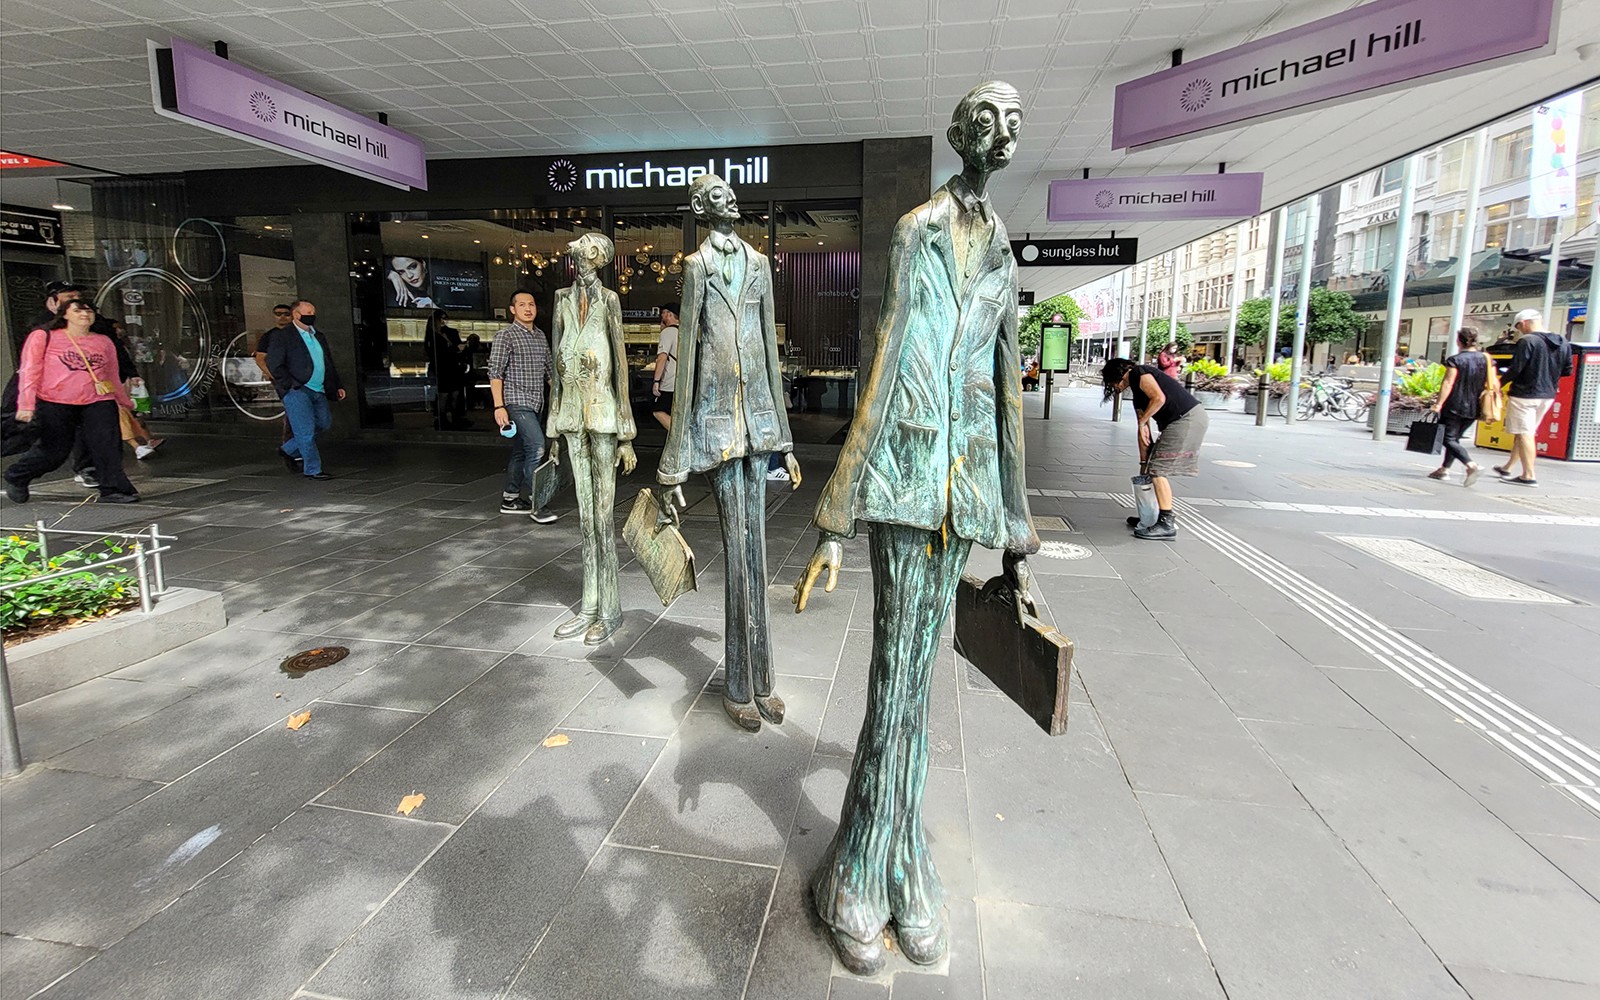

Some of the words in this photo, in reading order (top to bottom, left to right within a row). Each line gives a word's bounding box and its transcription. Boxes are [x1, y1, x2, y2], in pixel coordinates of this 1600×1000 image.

[1221, 39, 1356, 98] michael
[1367, 19, 1422, 58] hill
[283, 110, 362, 150] michael
[366, 137, 388, 159] hill
[585, 158, 715, 190] michael
[725, 156, 768, 185] hill
[1119, 190, 1187, 205] michael
[1192, 190, 1215, 203] hill
[1367, 210, 1398, 225] ZARA
[1042, 244, 1096, 261] sunglass
[1098, 244, 1120, 257] hut
[1470, 302, 1513, 314] ZARA
